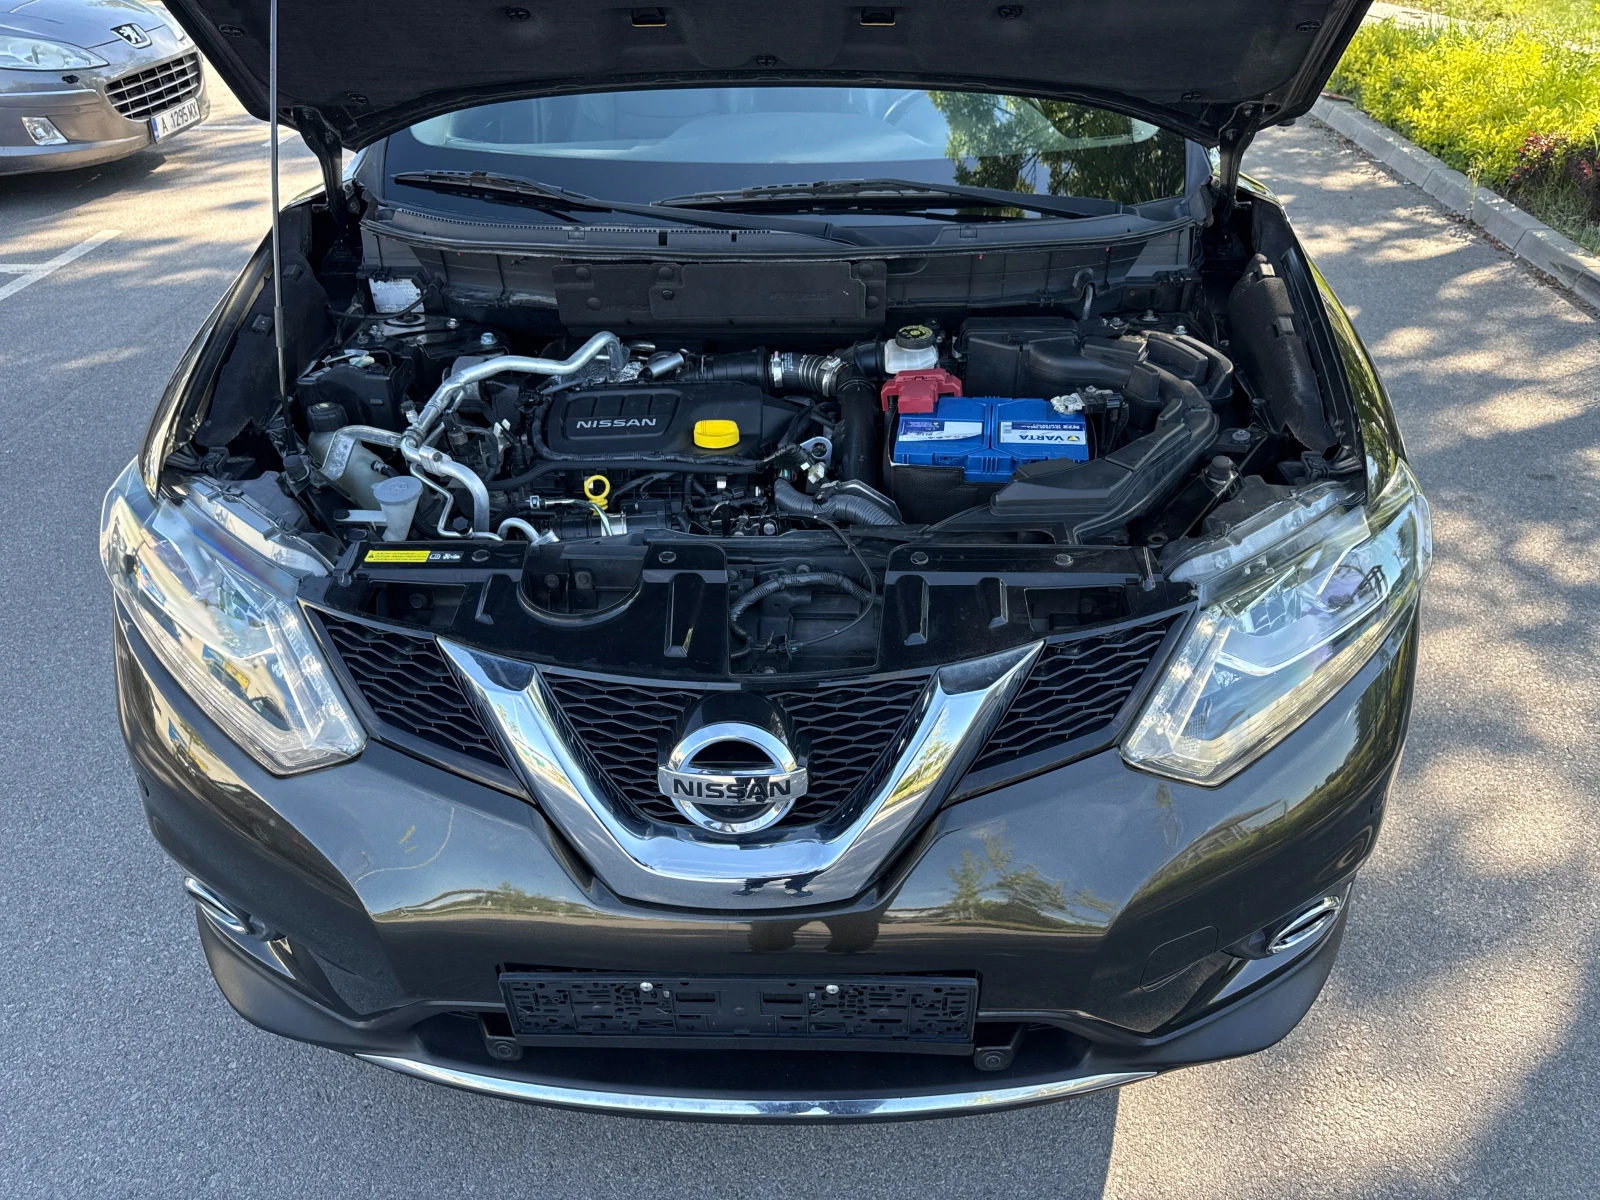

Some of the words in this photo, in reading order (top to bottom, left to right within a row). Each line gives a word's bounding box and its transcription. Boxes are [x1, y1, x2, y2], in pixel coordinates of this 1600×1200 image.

[161, 116, 169, 134] A
[170, 106, 189, 128] 1295
[576, 418, 657, 429] NISSAN
[1019, 434, 1065, 442] VARTA
[673, 778, 791, 799] NISSAN
